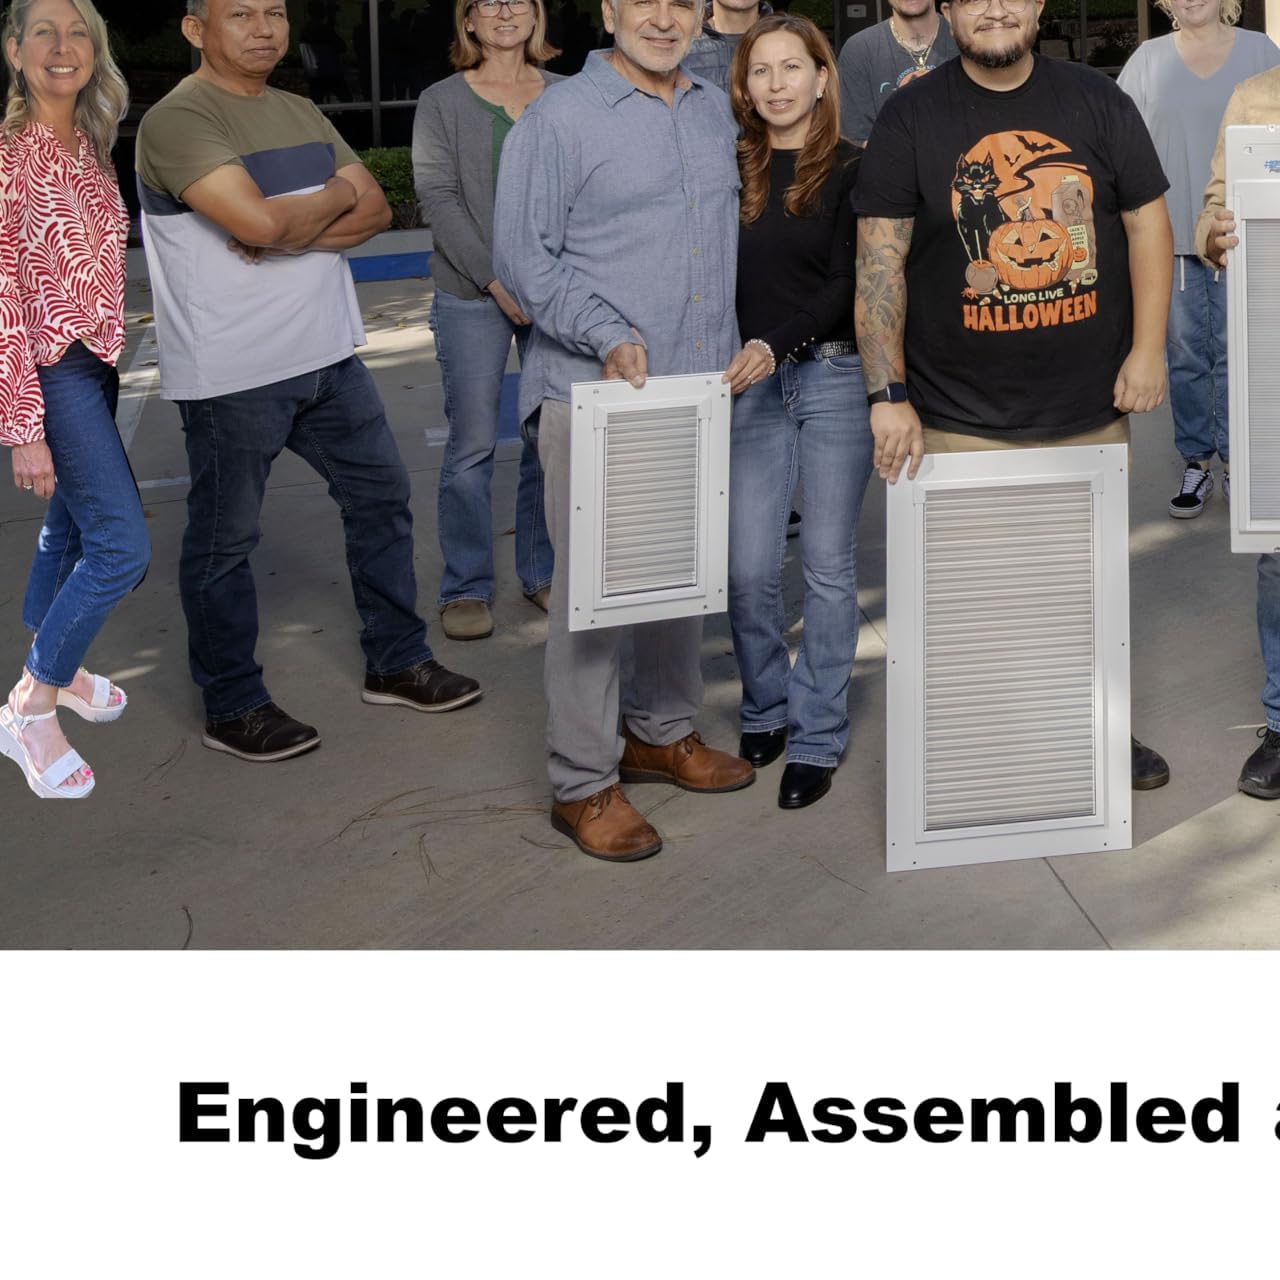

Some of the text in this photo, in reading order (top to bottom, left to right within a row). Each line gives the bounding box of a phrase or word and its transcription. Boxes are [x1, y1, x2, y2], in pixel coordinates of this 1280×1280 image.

[1003, 287, 1065, 304] LONG LIVE
[962, 290, 1097, 332] HALLOWEEN
